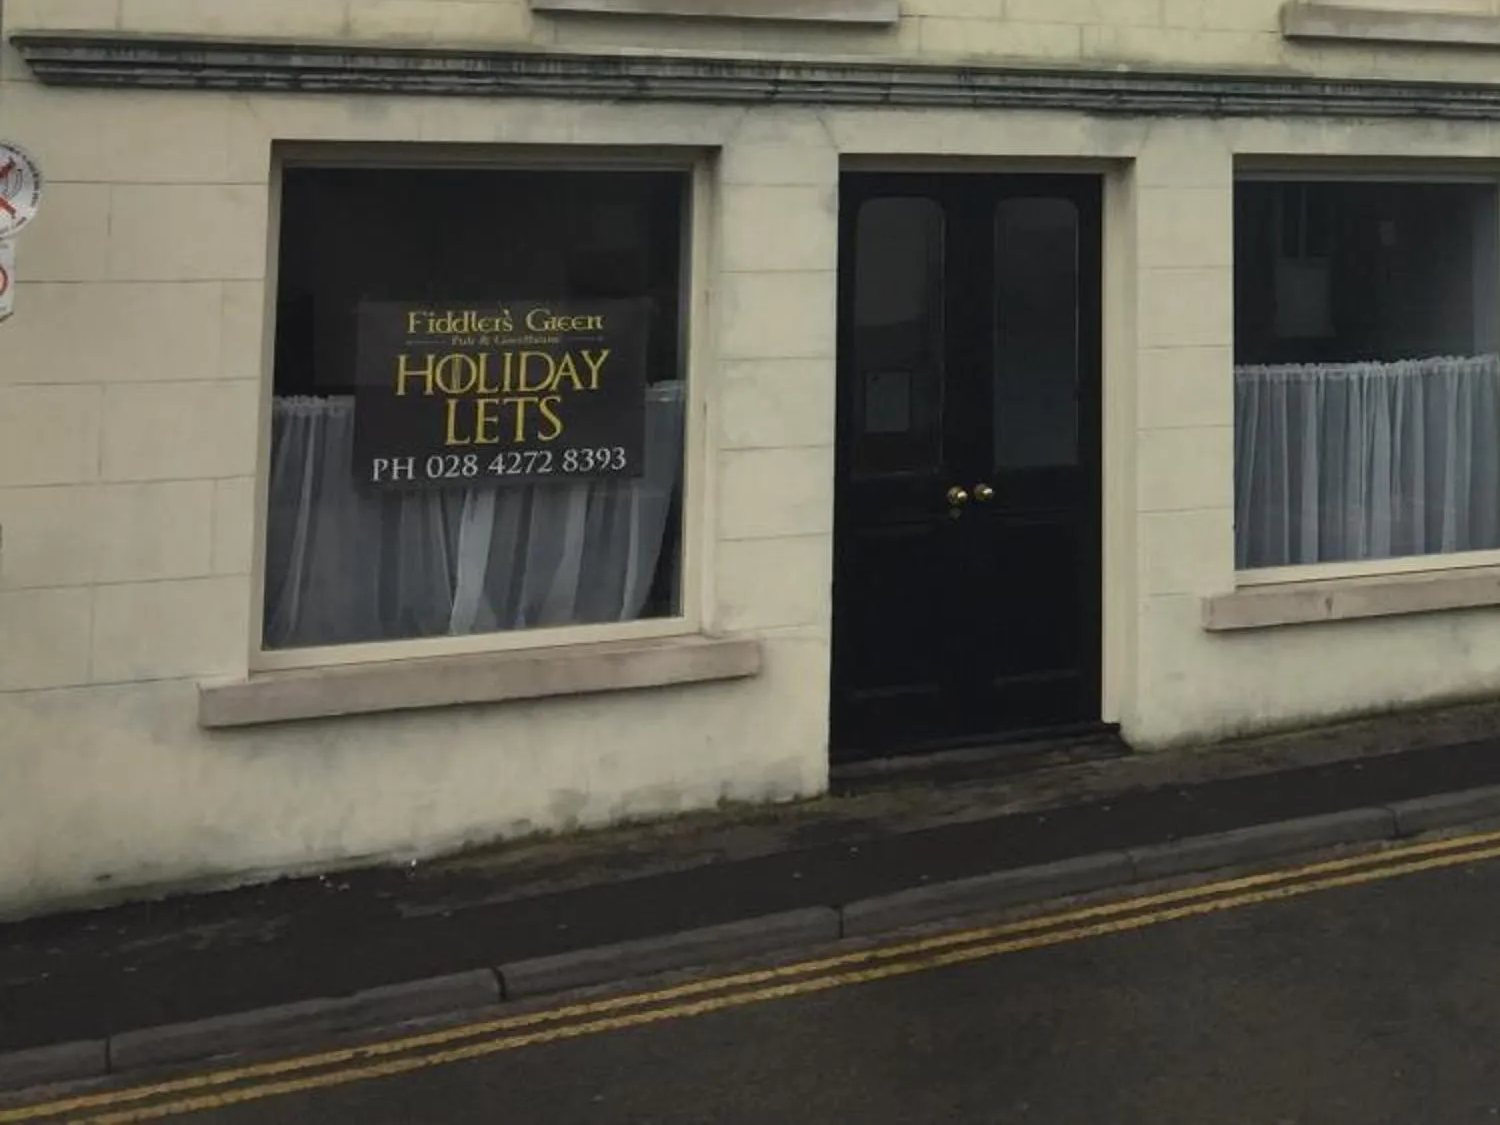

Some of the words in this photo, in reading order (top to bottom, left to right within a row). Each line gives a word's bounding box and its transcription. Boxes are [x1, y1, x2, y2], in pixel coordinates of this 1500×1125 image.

[406, 309, 513, 335] Fiddler's
[525, 308, 604, 332] Green
[395, 349, 611, 396] HOLIDAY
[444, 395, 563, 446] LETS
[372, 457, 415, 482] PH
[426, 454, 478, 479] 028
[488, 450, 553, 475] 4272
[562, 447, 627, 472] 8393
